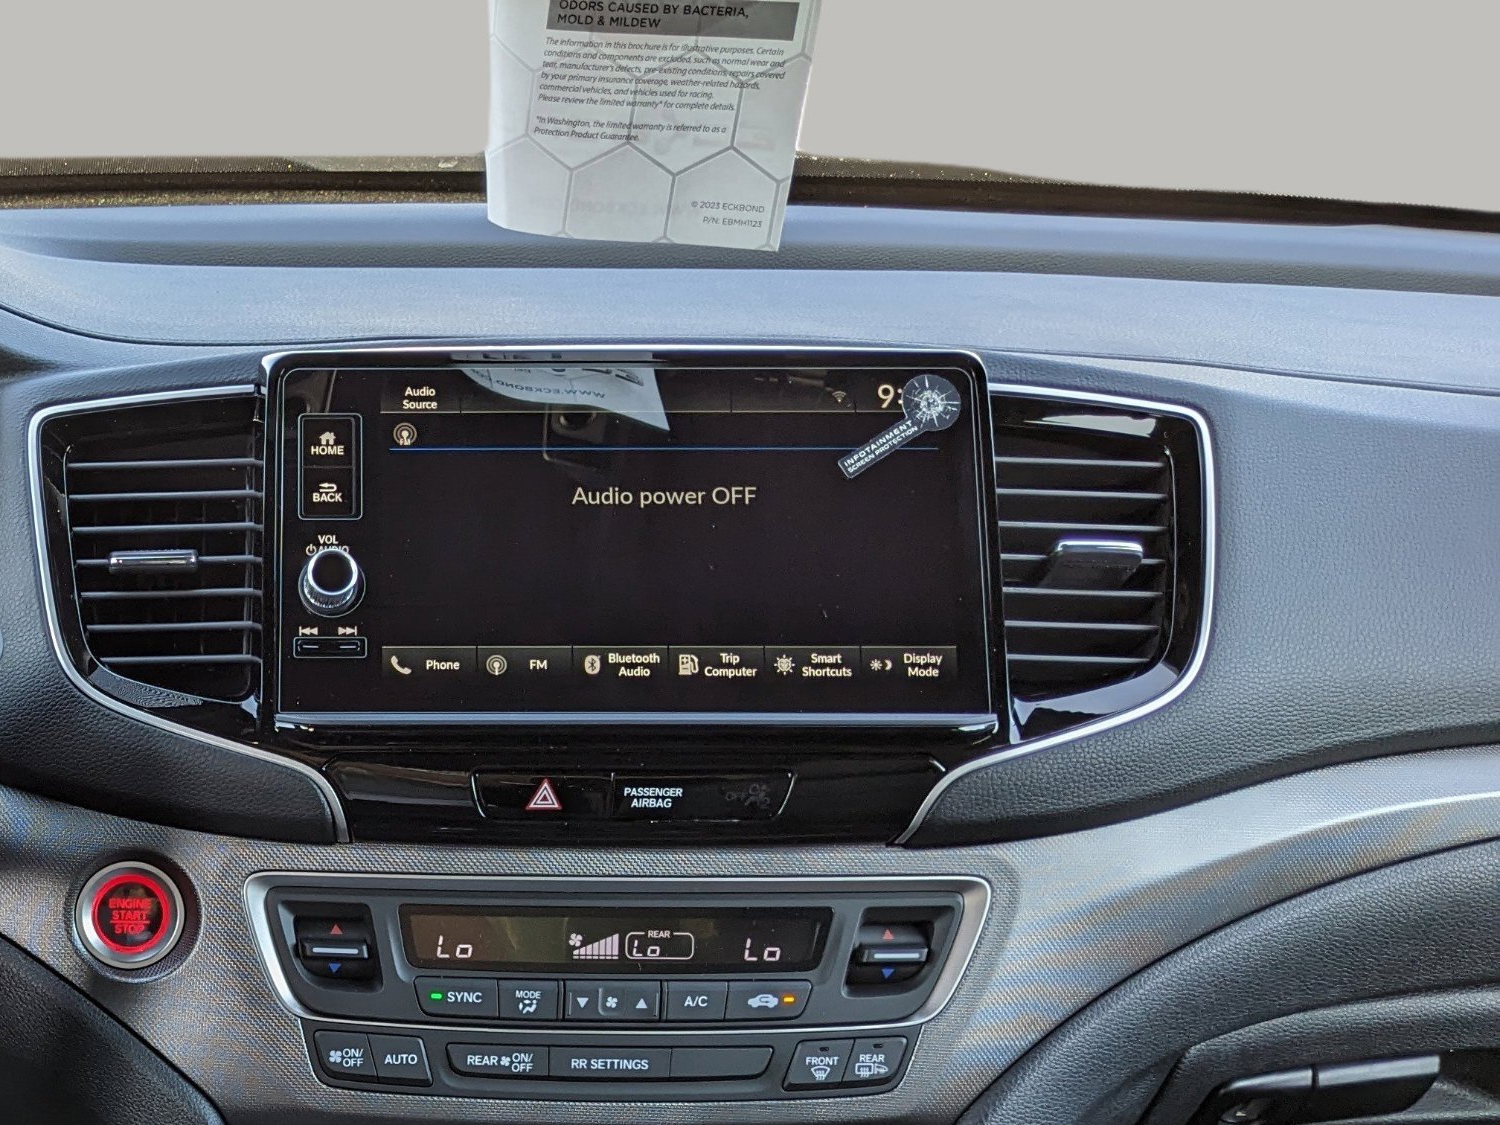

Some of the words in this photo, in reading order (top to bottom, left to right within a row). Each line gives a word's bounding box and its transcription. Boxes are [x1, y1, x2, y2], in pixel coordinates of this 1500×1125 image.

[560, 0, 604, 12] ODORS
[608, 3, 659, 13] CAUSED
[663, 4, 679, 14] BY
[683, 5, 748, 19] BACTERIA,
[557, 14, 594, 25] MOLD
[597, 16, 605, 26] &
[609, 17, 661, 28] MILDEW
[546, 38, 559, 46] The
[559, 38, 604, 48] information
[605, 40, 612, 49] in
[613, 41, 627, 49] this
[628, 41, 661, 51] brochure
[661, 43, 668, 51] is
[669, 43, 680, 52] for
[757, 47, 784, 56] Certain
[544, 49, 581, 58] conditions
[582, 51, 597, 59] and
[598, 52, 643, 63] components
[721, 57, 748, 66] normal
[770, 59, 785, 68] and
[540, 70, 549, 81] by
[550, 73, 566, 82] your
[568, 72, 597, 83] primary
[598, 73, 633, 83] insurance
[670, 77, 728, 88] weather-related
[756, 70, 786, 79] covered
[539, 82, 581, 92] commercial
[613, 86, 629, 94] and
[630, 87, 658, 96] vehicles
[659, 88, 677, 96] used
[677, 89, 689, 97] for
[538, 93, 561, 102] Please
[561, 94, 585, 103] review
[587, 96, 598, 104] the
[600, 96, 625, 105] limited
[663, 99, 674, 108] for
[675, 100, 709, 112] complete
[547, 115, 591, 128] Washington,
[592, 118, 605, 127] the
[606, 119, 631, 128] limited
[632, 121, 665, 132] warranty
[666, 122, 673, 130] is
[674, 123, 701, 132] referred
[703, 124, 710, 132] to
[533, 126, 569, 136] Protection
[570, 128, 598, 138] Product
[700, 201, 720, 210] 2023
[722, 203, 764, 213] ECKBOND
[404, 387, 436, 397] Audio
[402, 400, 438, 409] Source
[844, 420, 913, 467] INFOTAINMENT
[311, 445, 345, 456] HOME
[847, 453, 875, 473] SCREEN
[875, 426, 918, 455] PROTECTION
[313, 492, 342, 502] BACK
[571, 487, 633, 505] Audio
[640, 490, 705, 508] power
[712, 486, 757, 505] OFF
[317, 535, 338, 544] VOL
[608, 653, 660, 664] Bluetooth
[720, 653, 740, 665] Trip
[810, 653, 842, 664] Smart
[903, 653, 942, 665] Display
[425, 660, 461, 670] Phone
[529, 660, 548, 670] FM
[618, 666, 651, 677] Audio
[704, 667, 758, 678] Computer
[802, 666, 852, 677] Shortcuts
[908, 667, 939, 677] Mode
[624, 787, 683, 797] PASSENGER
[630, 798, 672, 808] AIRBAG
[109, 898, 151, 909] ENGINE
[112, 910, 147, 920] START
[115, 925, 145, 934] STOP
[647, 930, 670, 938] REAR
[447, 992, 482, 1003] SYNC
[515, 990, 541, 999] MODE
[683, 995, 708, 1007] A/C
[342, 1048, 363, 1058] ON/
[511, 1053, 533, 1063] ON/
[859, 1054, 885, 1063] REAR
[343, 1058, 364, 1068] OFF
[384, 1054, 418, 1065] AUTO
[467, 1055, 498, 1066] REAR
[571, 1059, 587, 1069] RR
[590, 1059, 649, 1070] SETTINGS
[805, 1056, 839, 1066] FRONT
[511, 1063, 533, 1073] OFF
